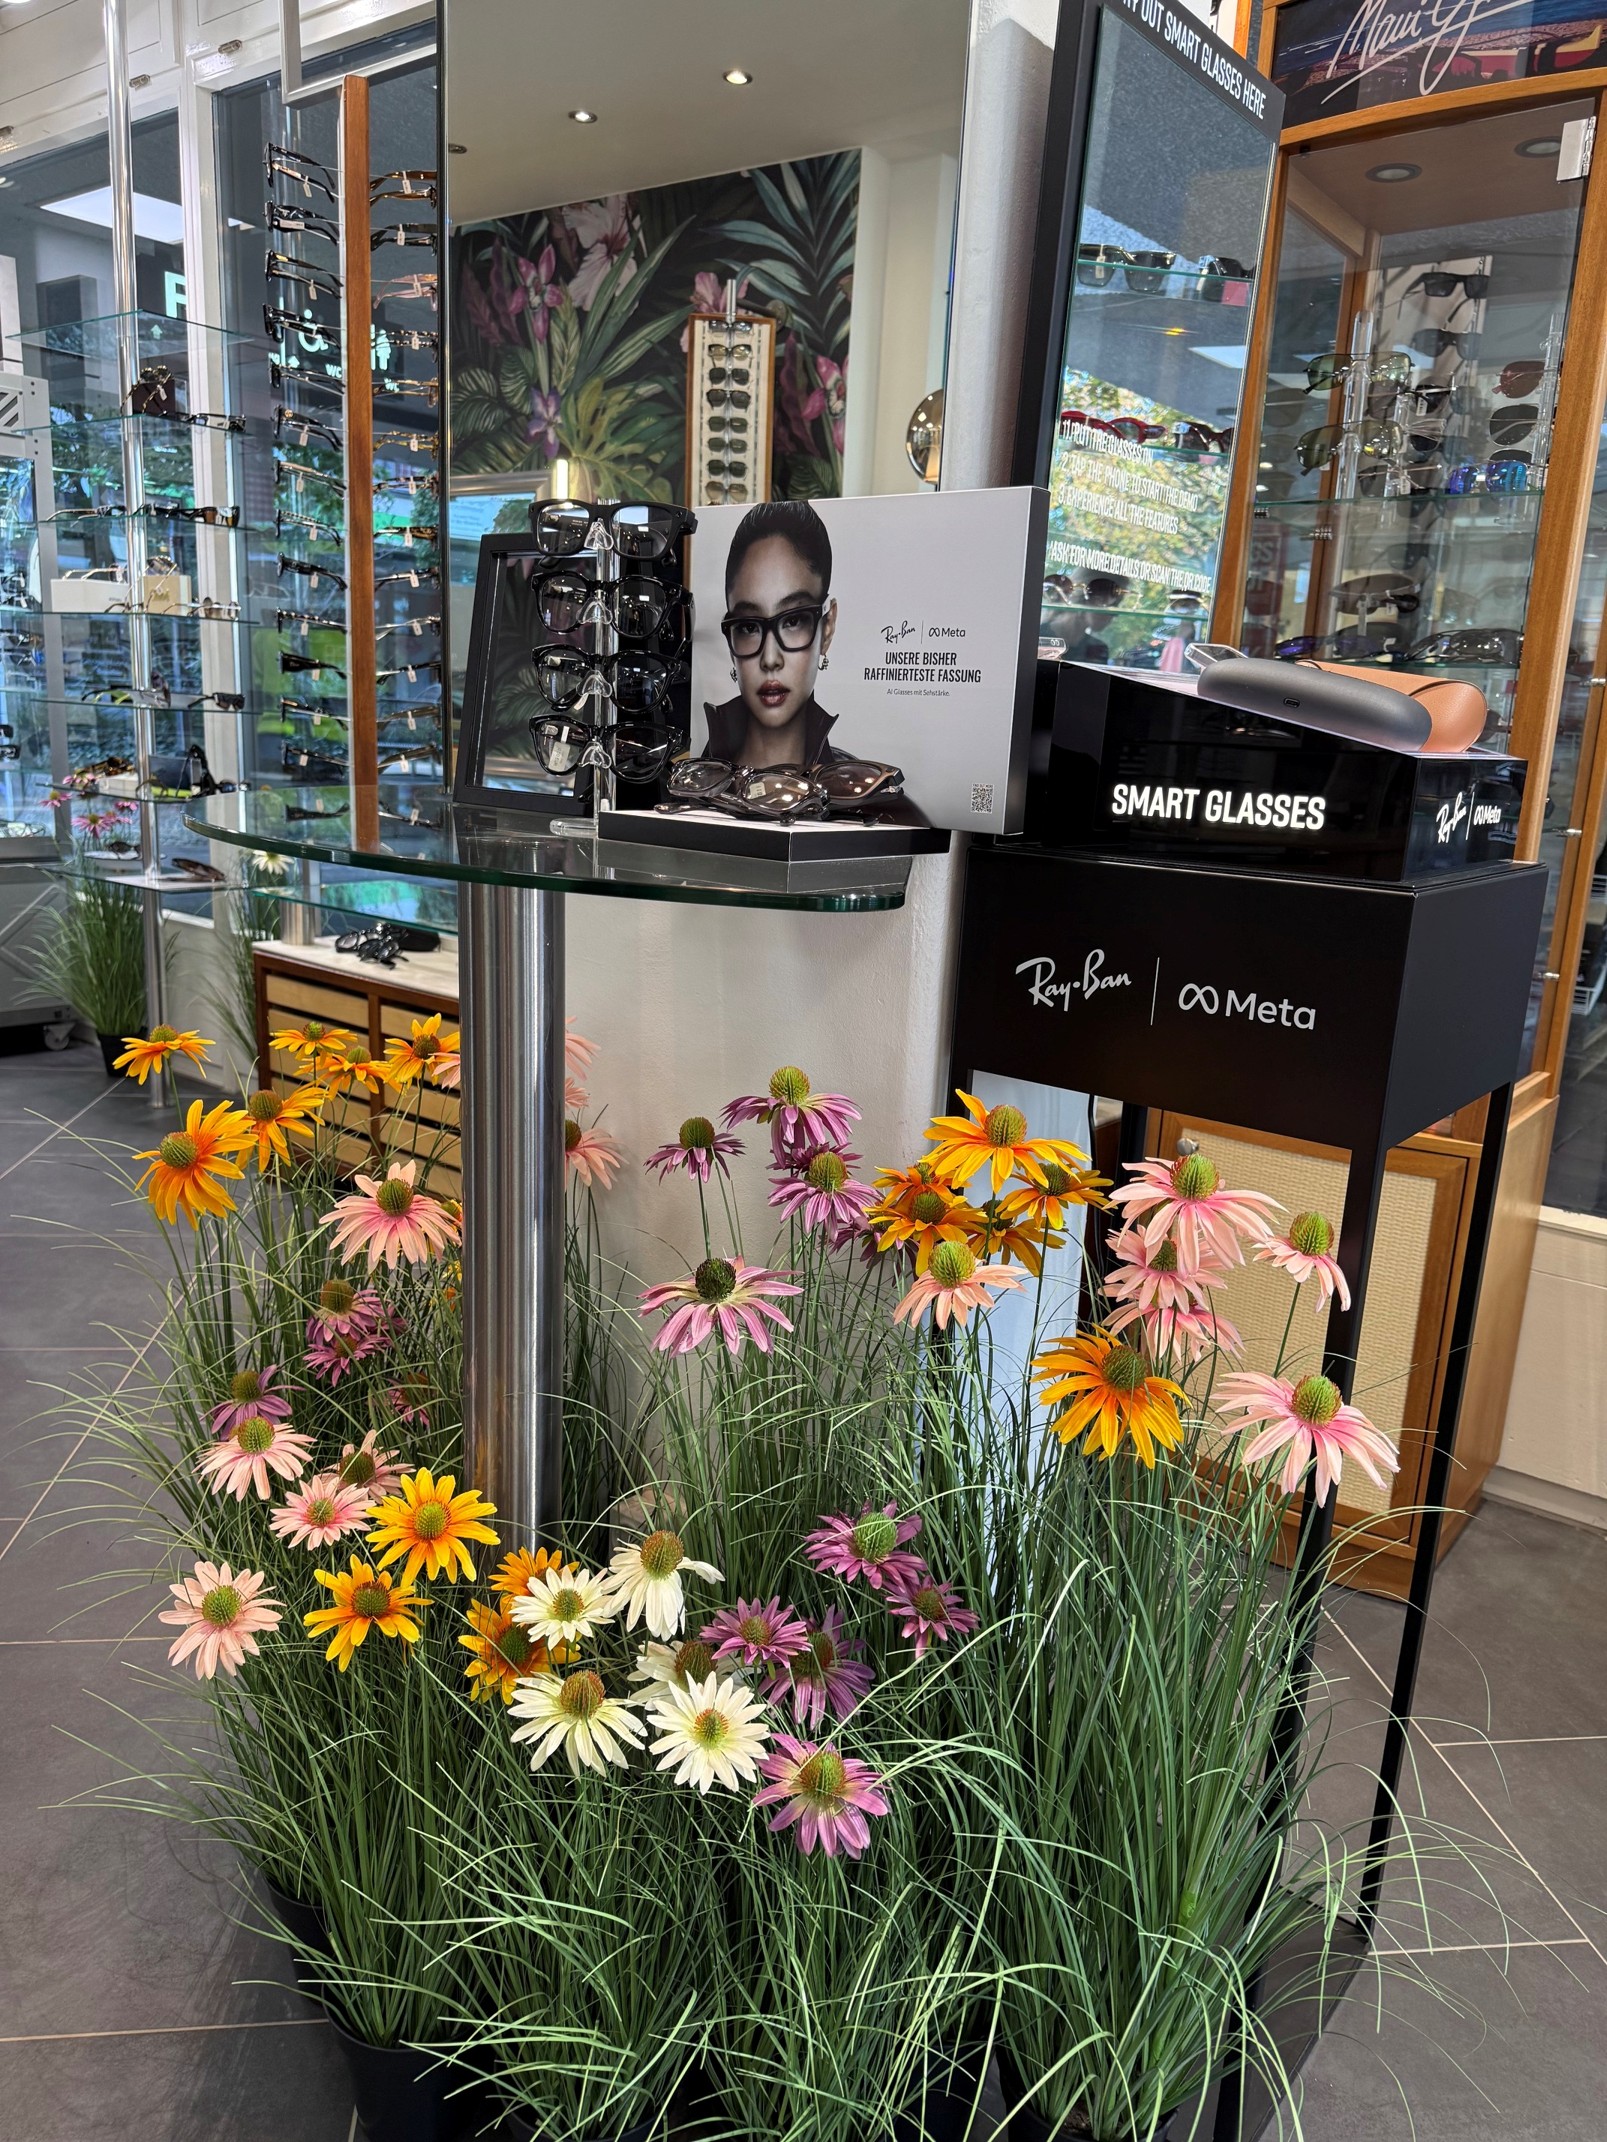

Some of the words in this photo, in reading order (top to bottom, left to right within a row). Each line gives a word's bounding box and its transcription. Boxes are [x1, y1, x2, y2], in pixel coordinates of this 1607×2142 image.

[1140, 0, 1165, 33] OUT
[1164, 11, 1202, 64] SMART
[1200, 43, 1243, 101] GLASSES
[1242, 79, 1267, 120] HERE
[1087, 458, 1103, 483] THE
[1104, 464, 1131, 492] PHONE
[1140, 477, 1163, 502] START
[1066, 486, 1115, 518] EXPERIENCE
[1114, 499, 1128, 522] ALL
[941, 627, 966, 638] Meta
[863, 667, 935, 682] RAFFINIERTESTE
[938, 668, 981, 683] FASSUNG
[885, 651, 920, 666] UNSERE
[922, 652, 957, 666] BISHER
[893, 688, 913, 696] Glasses
[1111, 783, 1201, 820] SMART
[1204, 789, 1327, 831] GLASSES
[1225, 989, 1317, 1031] Meta
